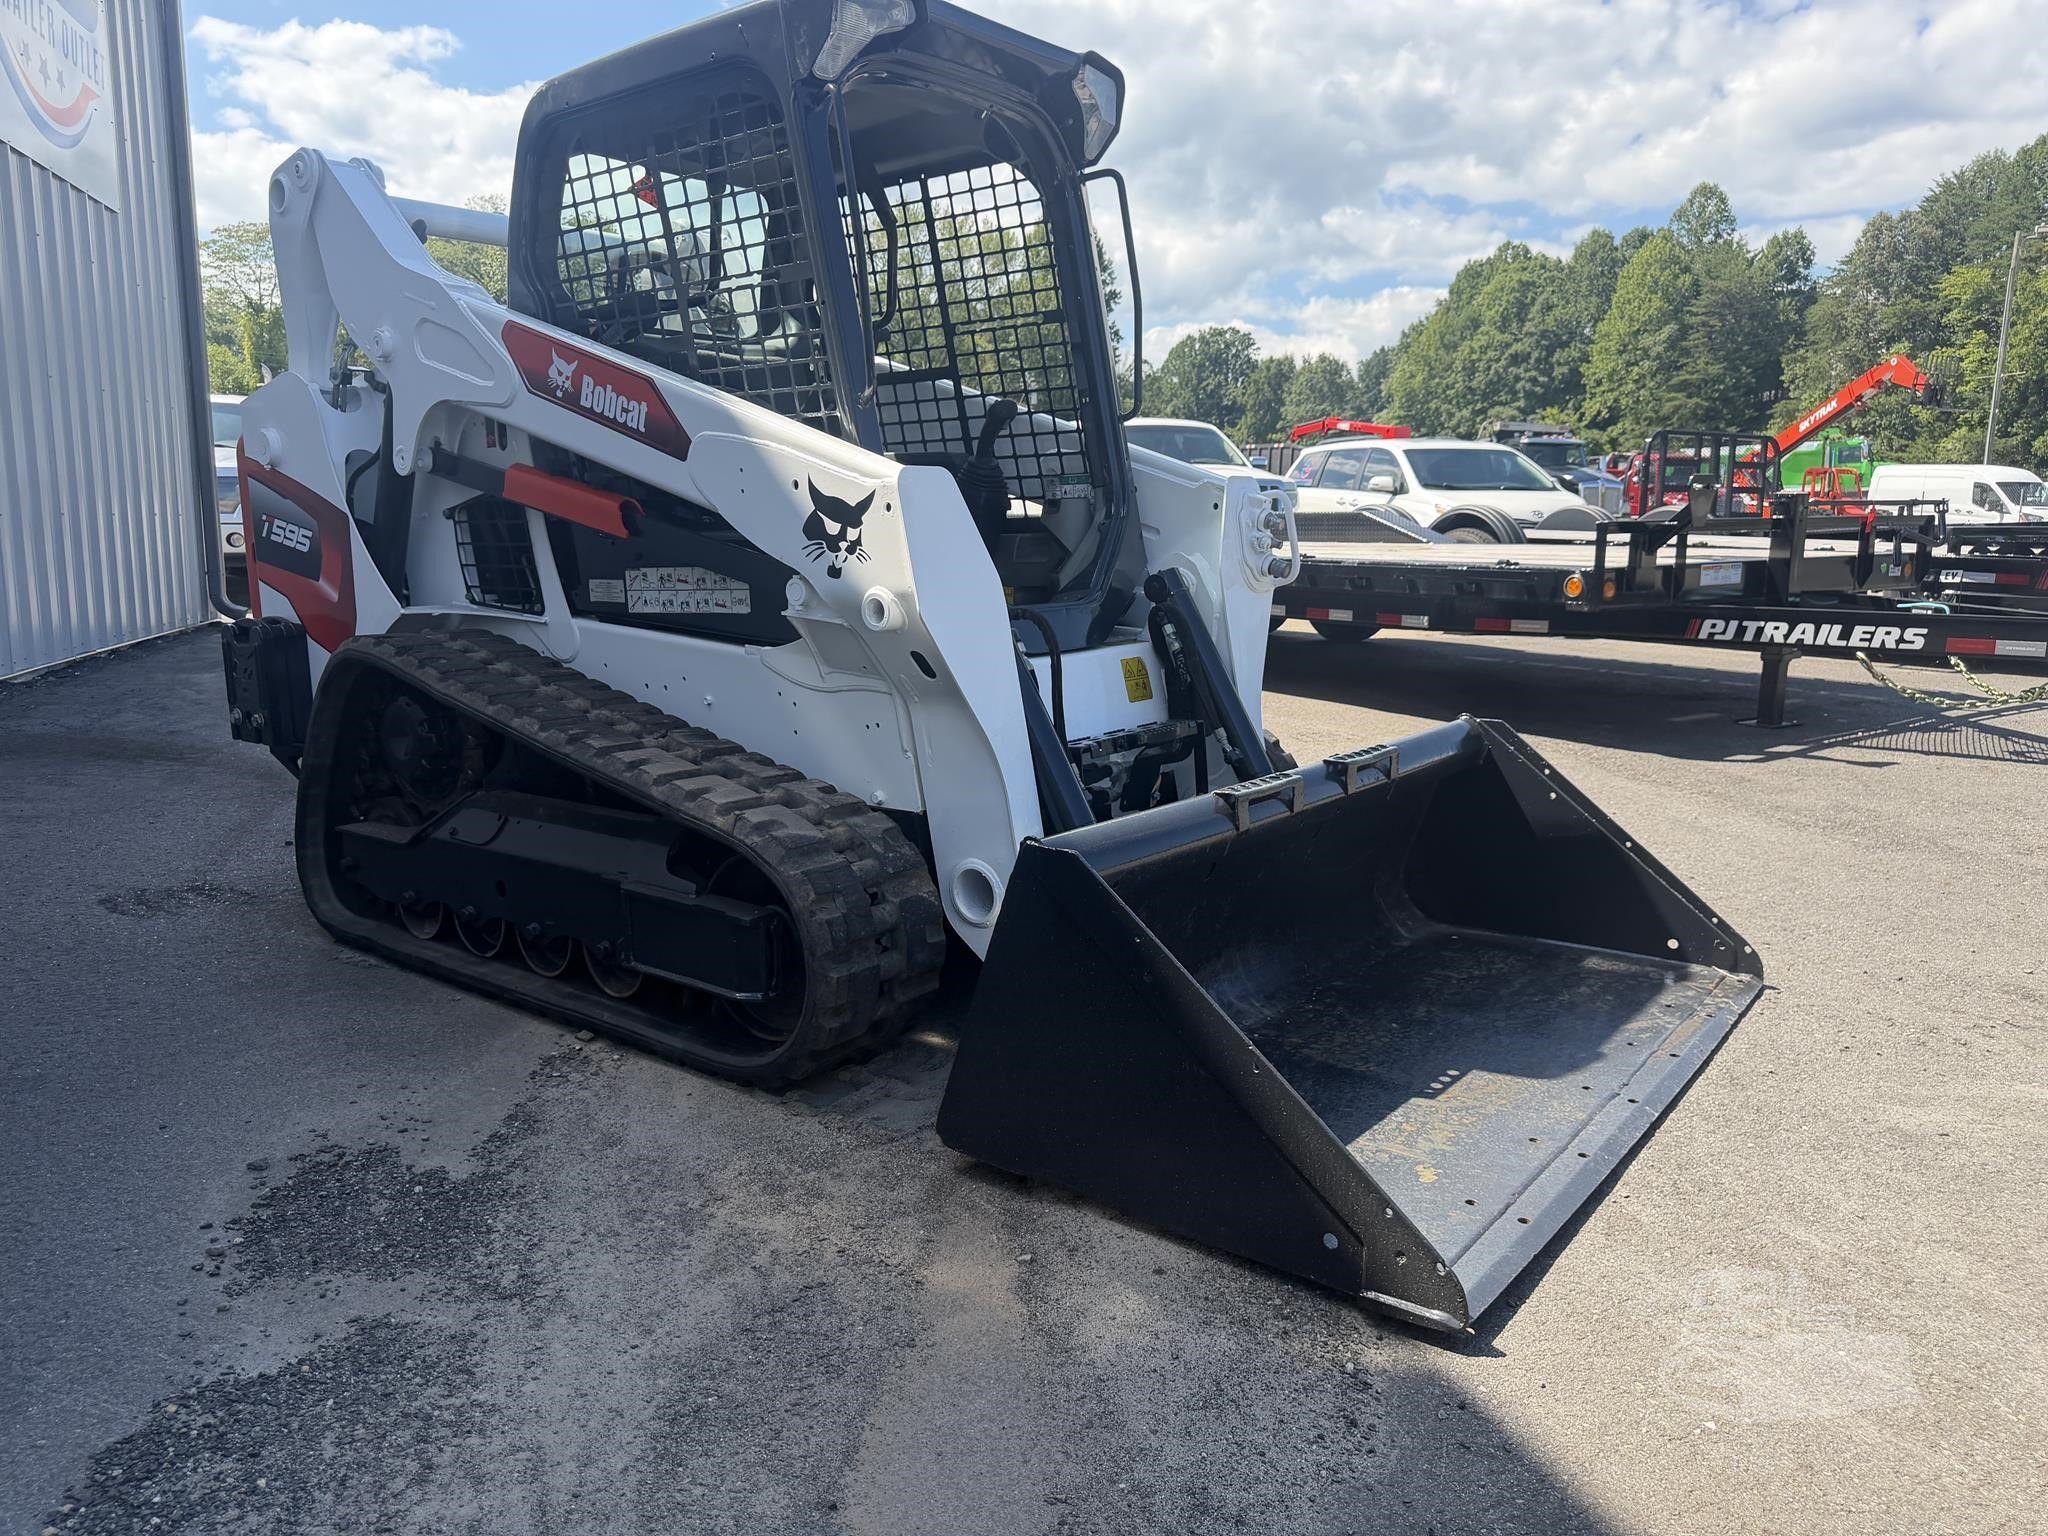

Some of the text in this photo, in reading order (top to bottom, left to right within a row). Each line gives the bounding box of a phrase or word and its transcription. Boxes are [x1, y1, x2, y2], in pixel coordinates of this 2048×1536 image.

[2, 0, 105, 91] AILER OUTLET
[580, 374, 648, 433] Bobcat
[1798, 398, 1838, 432] SKYTRAK
[1697, 618, 1929, 650] PJ TRAILERS
